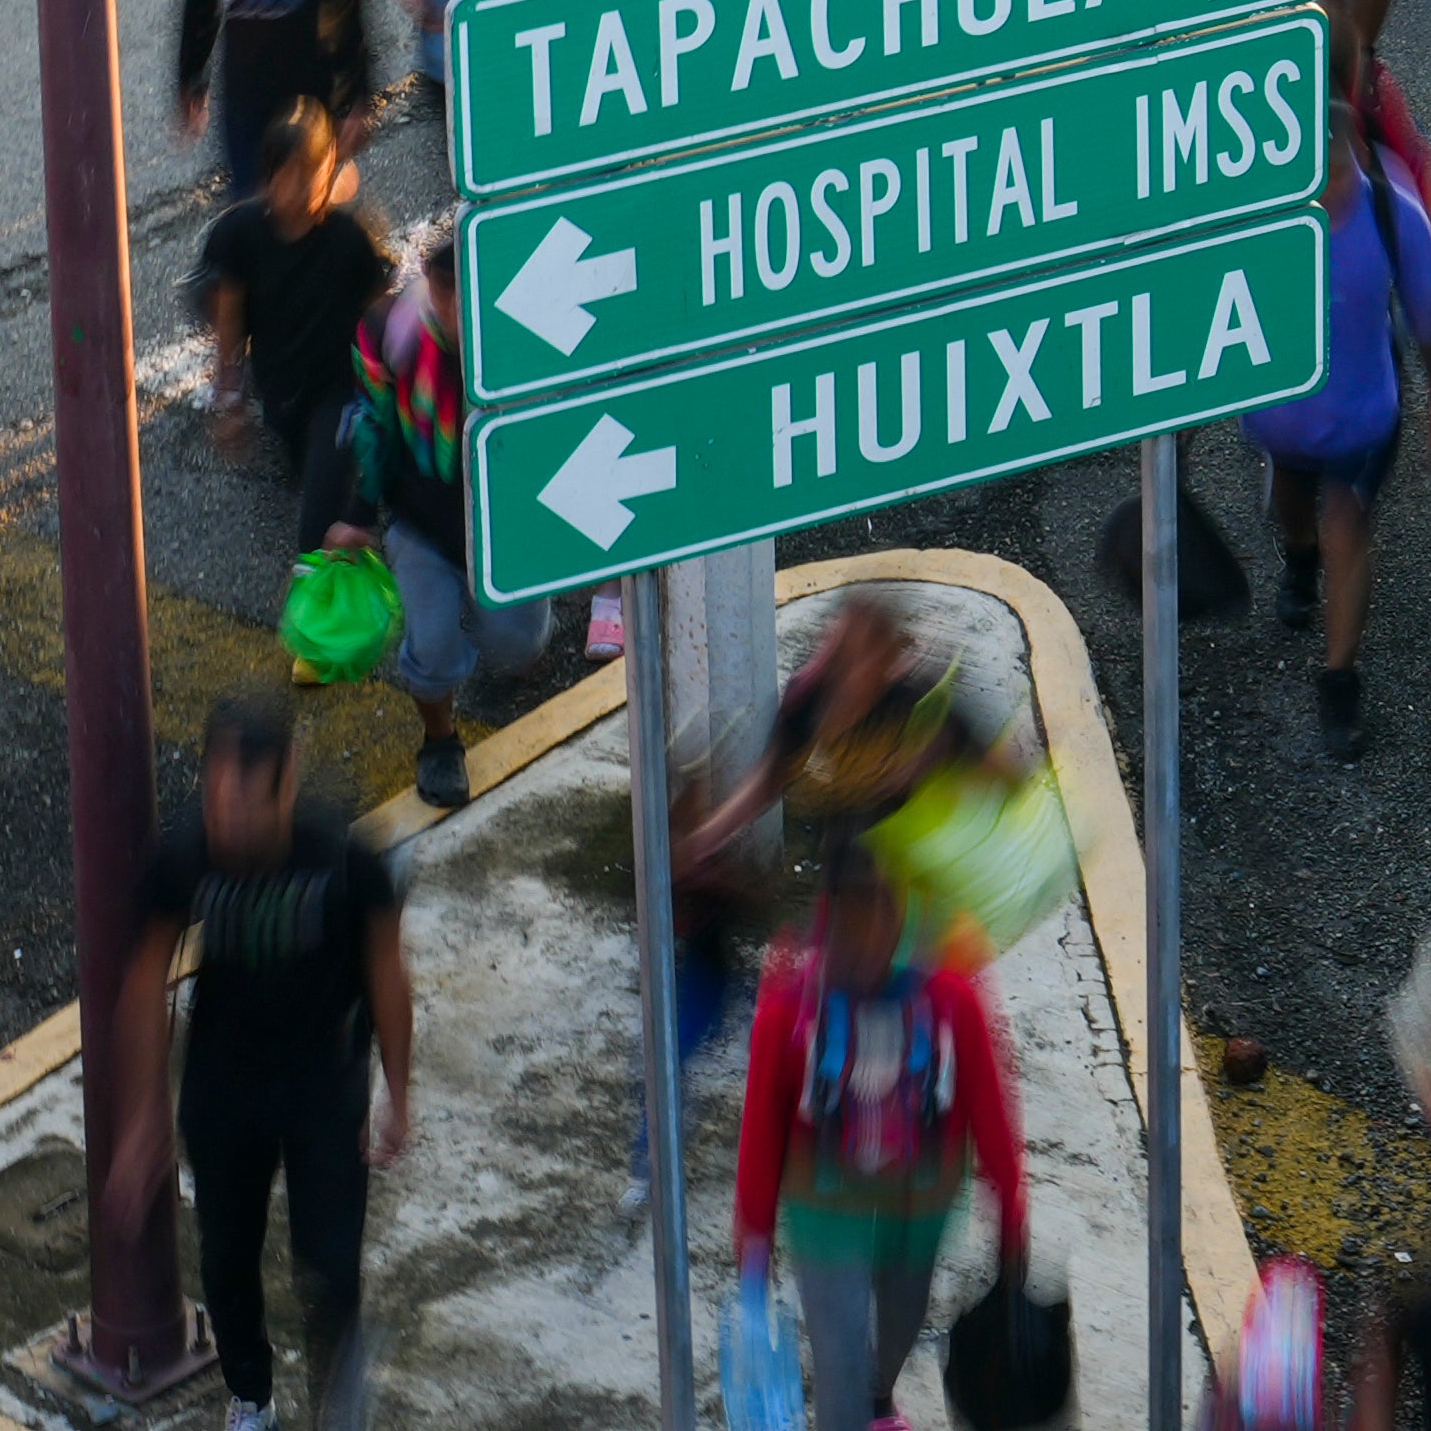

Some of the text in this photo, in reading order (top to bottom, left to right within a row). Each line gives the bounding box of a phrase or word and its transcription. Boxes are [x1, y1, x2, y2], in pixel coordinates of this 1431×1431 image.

[700, 59, 1302, 306] HOSPITAL IMSS
[772, 270, 1271, 489] HUIXTLA
